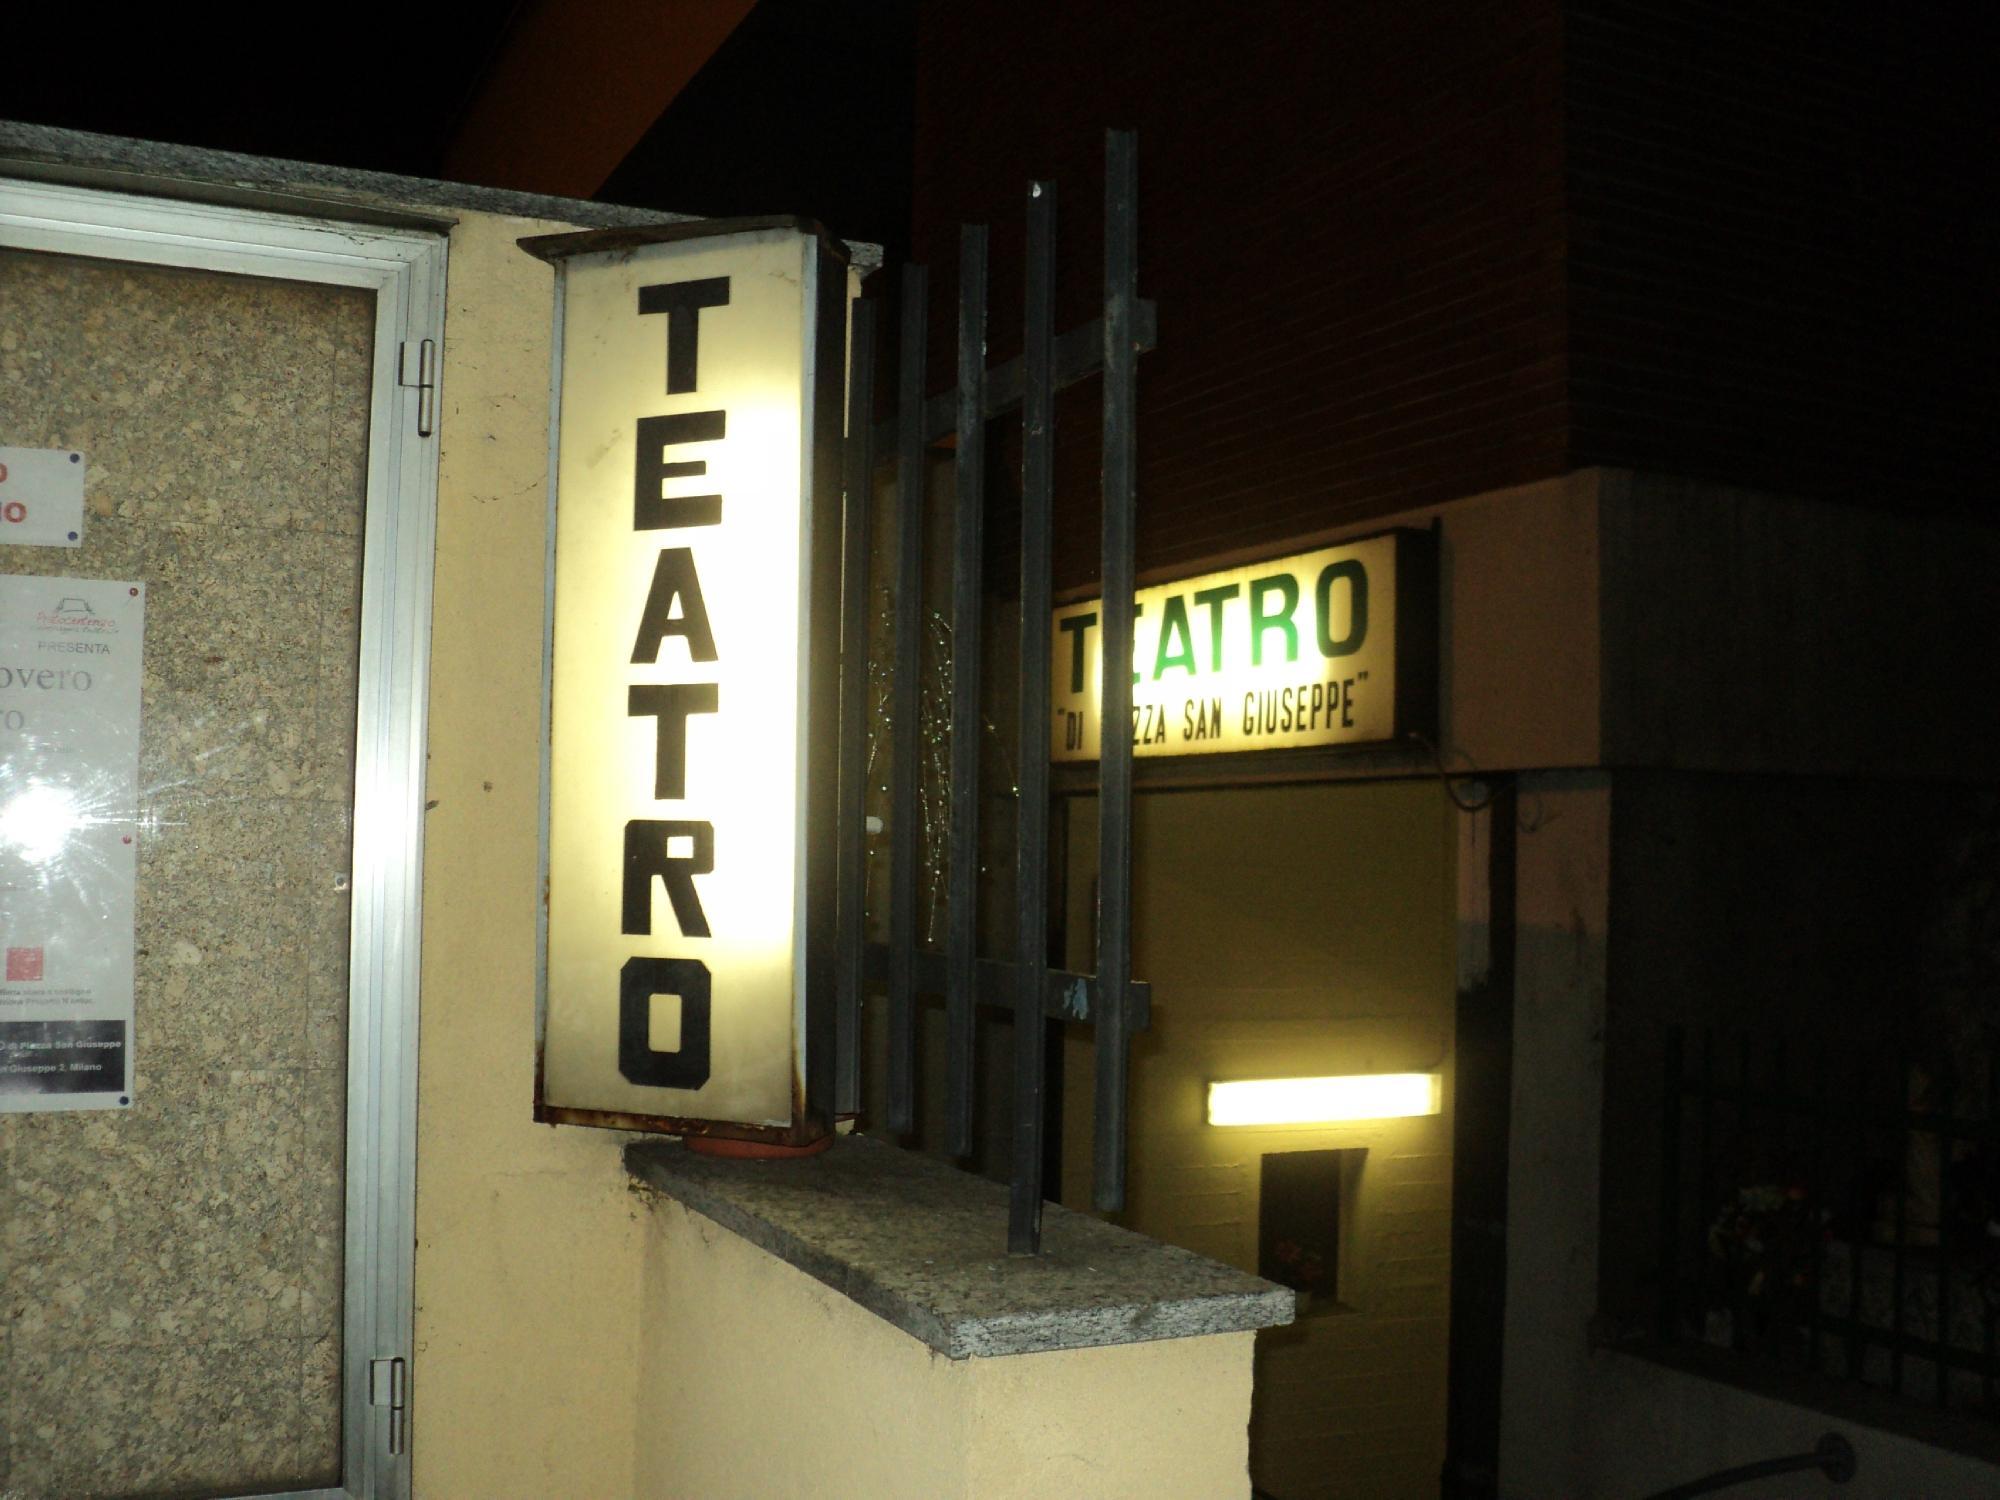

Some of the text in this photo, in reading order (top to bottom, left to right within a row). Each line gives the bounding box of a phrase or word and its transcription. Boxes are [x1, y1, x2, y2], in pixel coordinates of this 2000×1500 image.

[37, 640, 111, 655] PRESENTA
[619, 275, 730, 1088] TEATRO
[1182, 697, 1222, 741] SAN
[1242, 671, 1369, 737] GIUSEPPE"
[75, 1039, 122, 1050] Giuseppe
[69, 1062, 102, 1073] Milano
